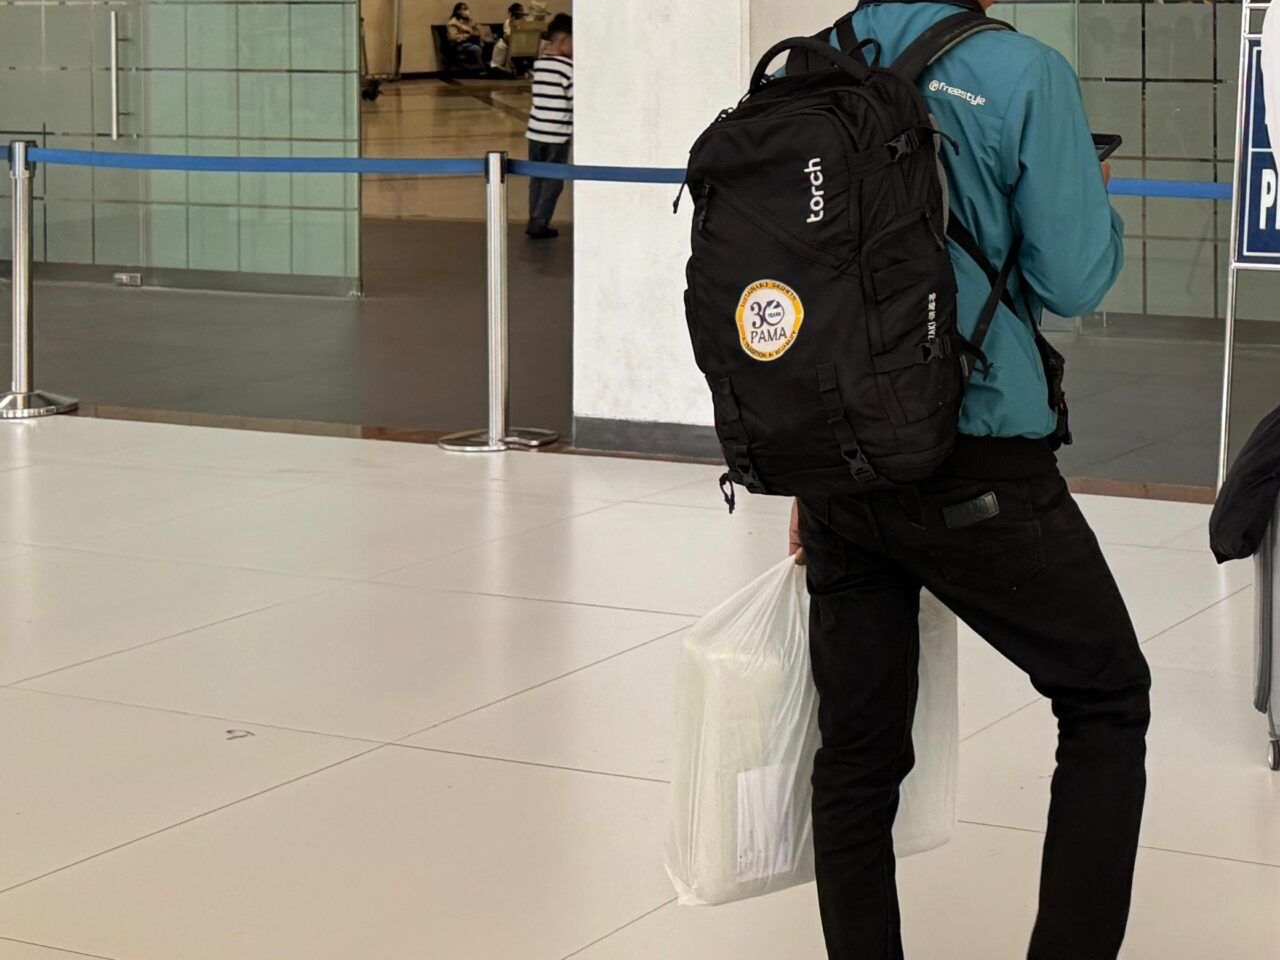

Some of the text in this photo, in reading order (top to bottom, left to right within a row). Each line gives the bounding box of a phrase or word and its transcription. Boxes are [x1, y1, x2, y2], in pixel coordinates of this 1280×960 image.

[939, 81, 986, 106] freestyle
[803, 157, 824, 223] torch
[750, 326, 788, 344] PAMA
